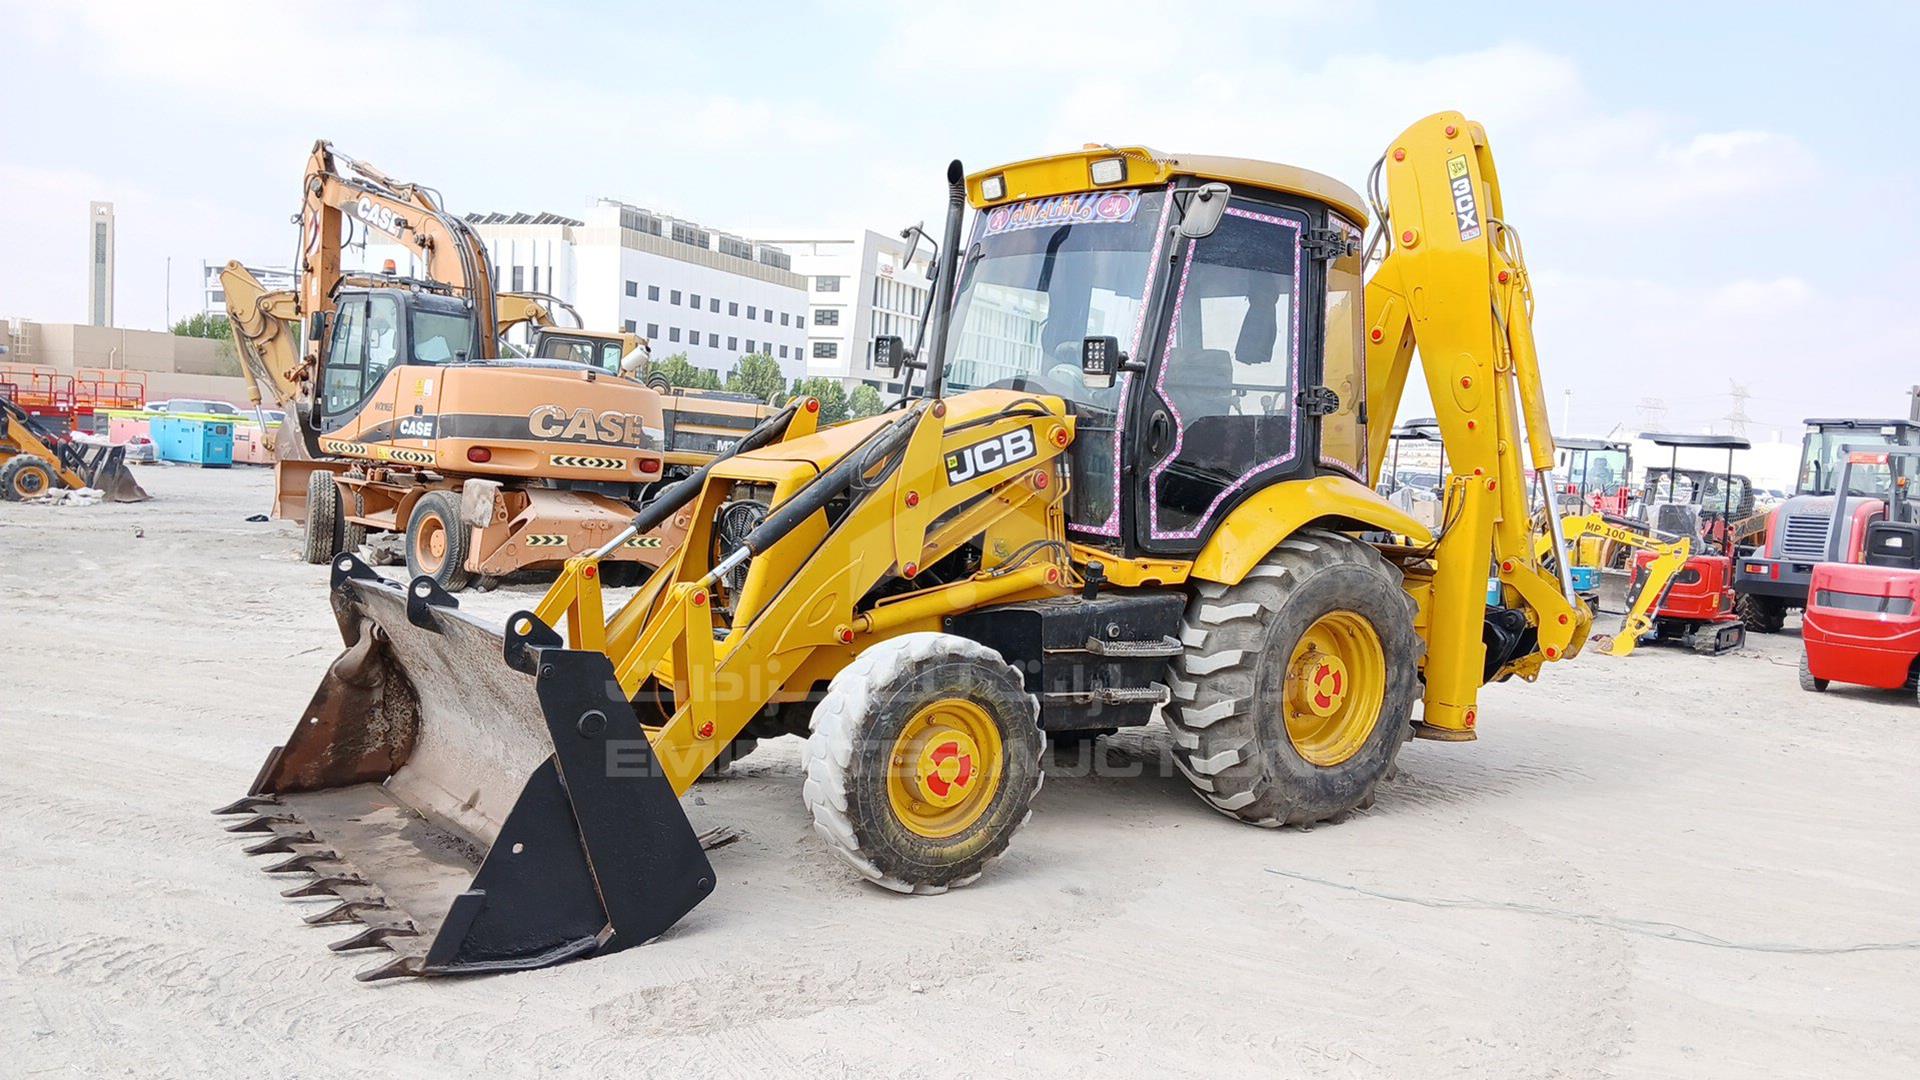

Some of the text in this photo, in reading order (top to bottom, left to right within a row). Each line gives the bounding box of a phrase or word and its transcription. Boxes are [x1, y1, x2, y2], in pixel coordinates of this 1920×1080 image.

[1452, 178, 1478, 230] 3CX
[400, 420, 433, 437] CASE
[528, 405, 644, 445] CASE
[949, 428, 1033, 483] JCB
[1585, 522, 1626, 541] MP 100
